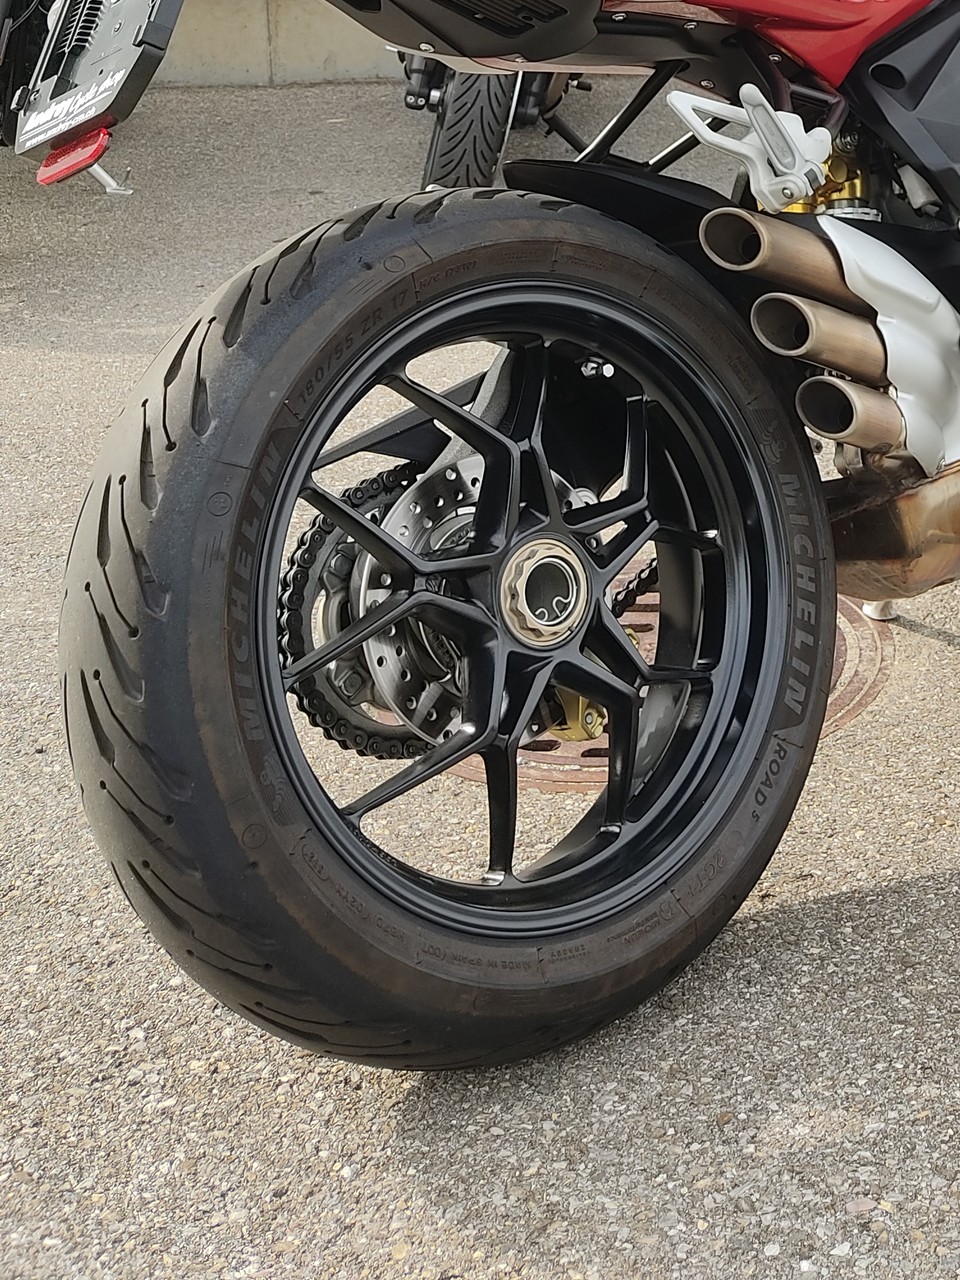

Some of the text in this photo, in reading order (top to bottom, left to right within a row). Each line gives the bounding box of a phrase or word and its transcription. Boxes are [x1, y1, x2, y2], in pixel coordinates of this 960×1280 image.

[300, 331, 354, 404] 180/55
[361, 307, 384, 337] ZR
[229, 441, 282, 742] MICHELIN
[777, 473, 817, 716] MICHELIN
[751, 741, 789, 824] ROAD 5
